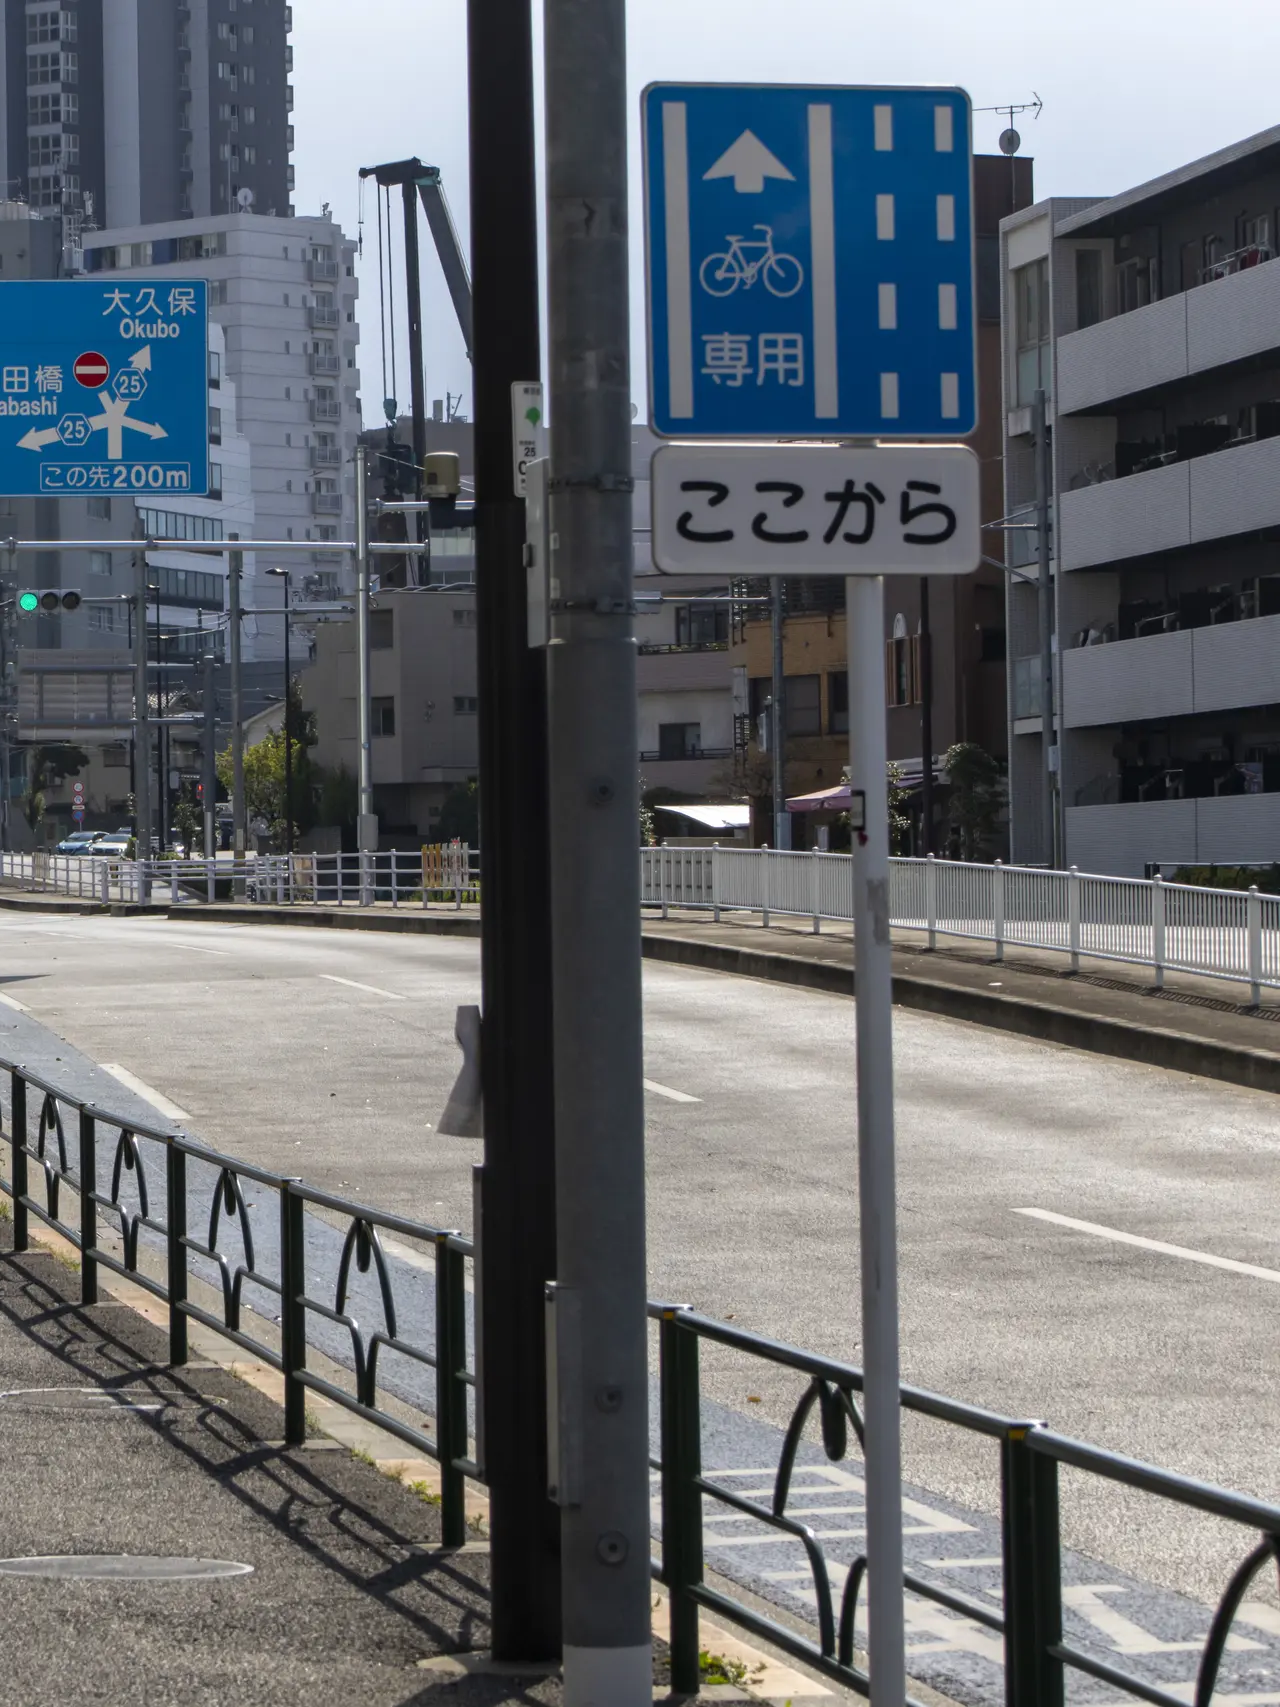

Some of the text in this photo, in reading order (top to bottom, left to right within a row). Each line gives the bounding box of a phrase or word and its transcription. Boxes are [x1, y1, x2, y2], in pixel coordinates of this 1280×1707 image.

[102, 288, 196, 316] 大久保
[119, 318, 180, 339] Okubo
[701, 332, 804, 387] 専用
[119, 376, 141, 393] 25
[63, 420, 85, 438] 25
[524, 447, 536, 457] 25
[45, 465, 188, 488] この先200m
[676, 478, 958, 545] ここから
